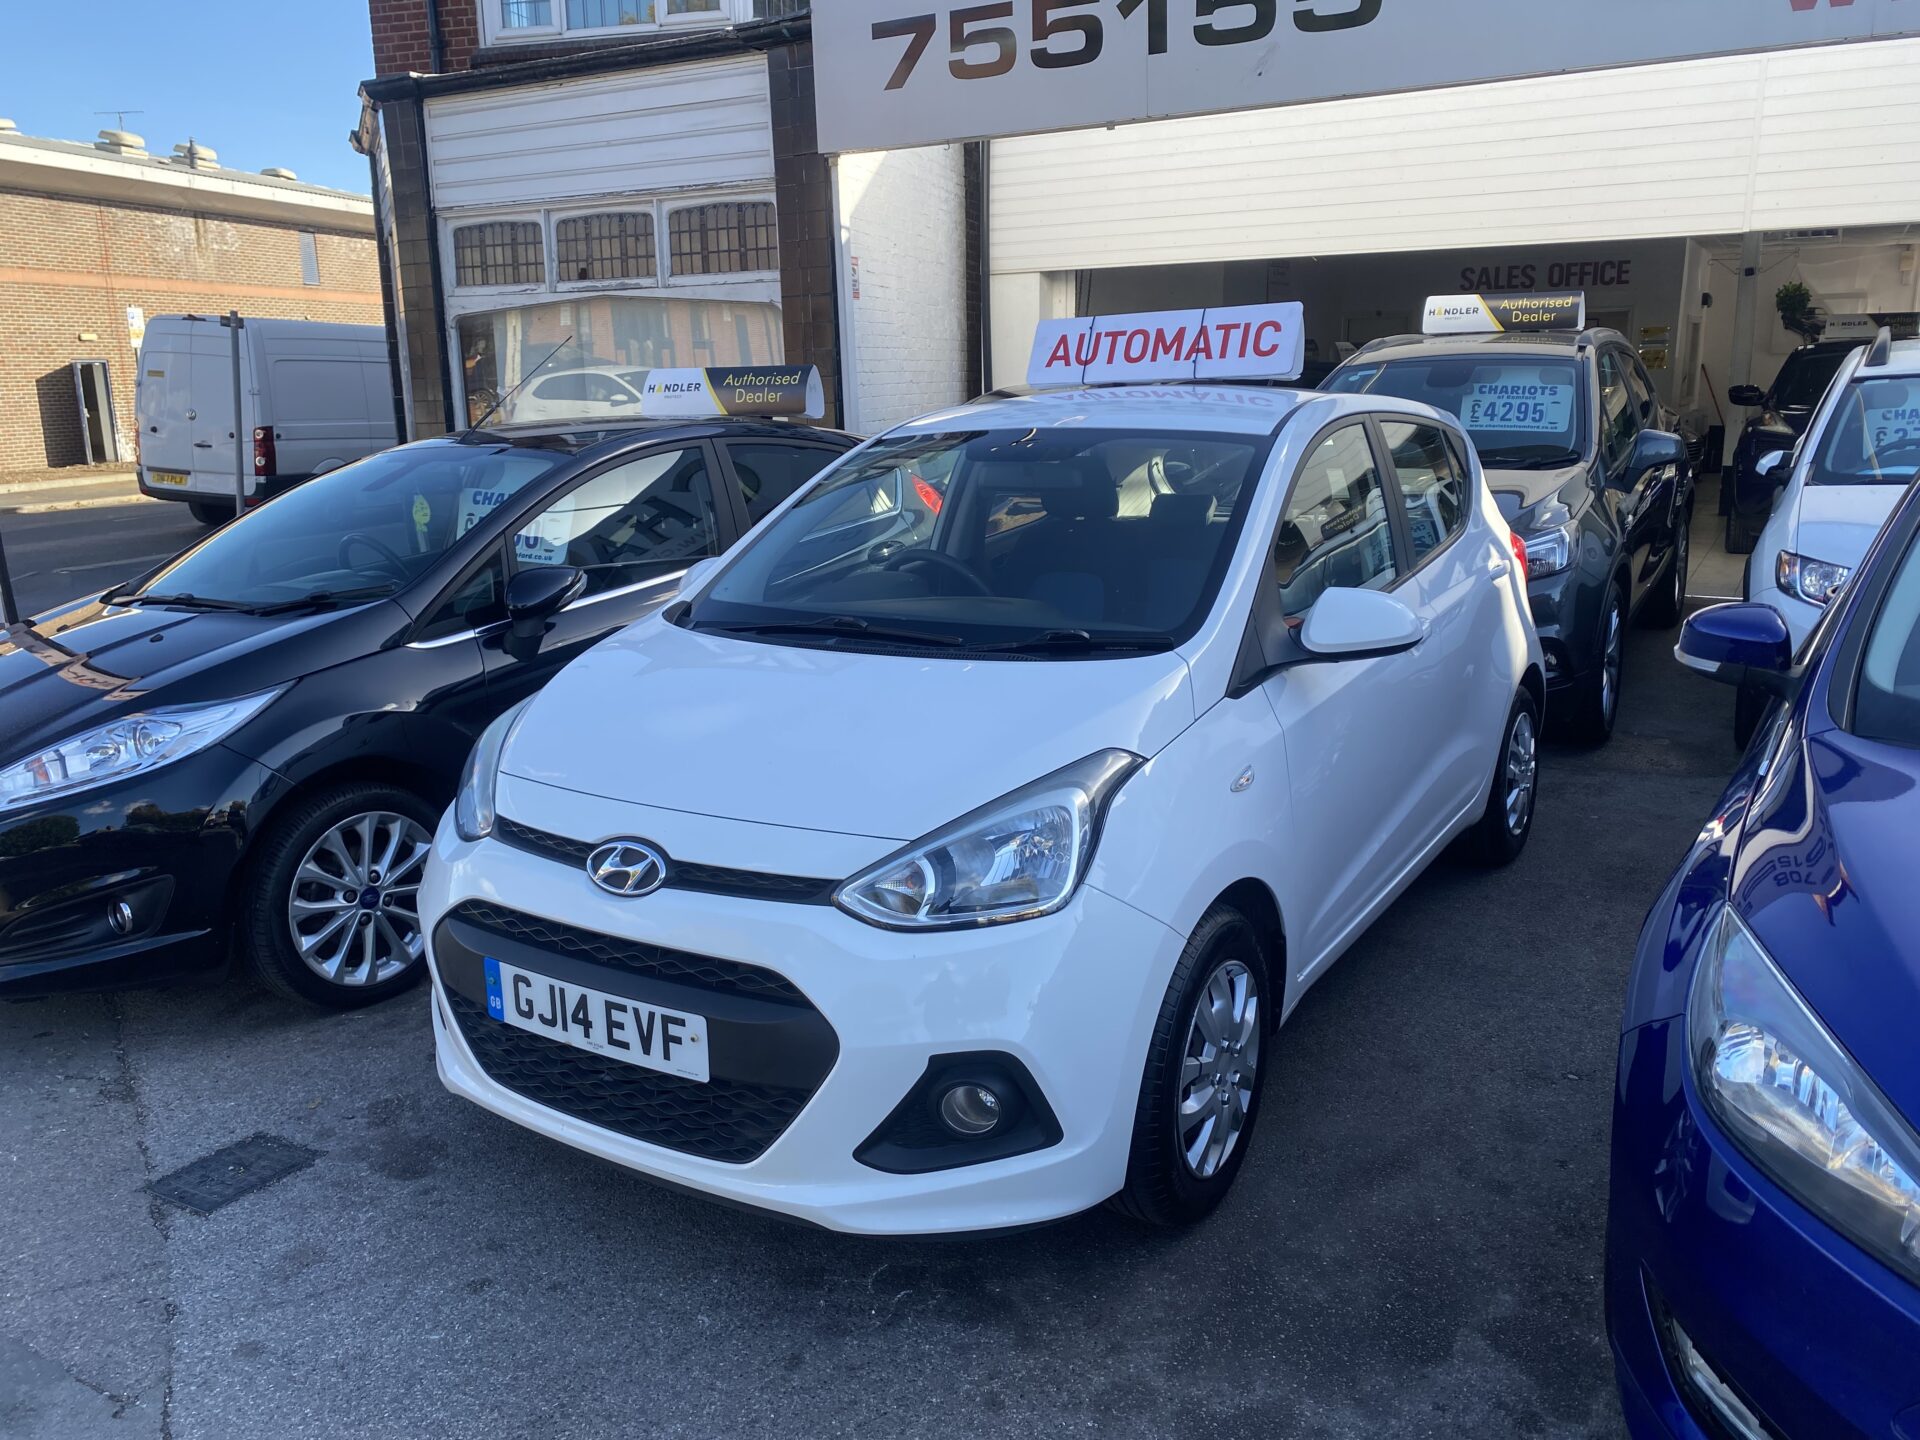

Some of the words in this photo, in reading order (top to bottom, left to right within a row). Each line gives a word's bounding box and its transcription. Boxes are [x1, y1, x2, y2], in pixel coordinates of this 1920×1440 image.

[1459, 264, 1537, 292] SALES
[1547, 260, 1632, 288] OFFICE
[1500, 296, 1573, 310] Authorised
[1512, 310, 1557, 323] Dealer
[1044, 320, 1283, 368] AUTOMATIC
[723, 371, 802, 387] Authorised
[648, 382, 701, 394] HANDLER
[735, 388, 783, 403] Dealer
[1478, 384, 1559, 396] CHARIOTS
[1470, 401, 1545, 422] £4295
[490, 995, 502, 1010] GB
[513, 973, 593, 1039] GJ14
[604, 999, 687, 1062] EVF
